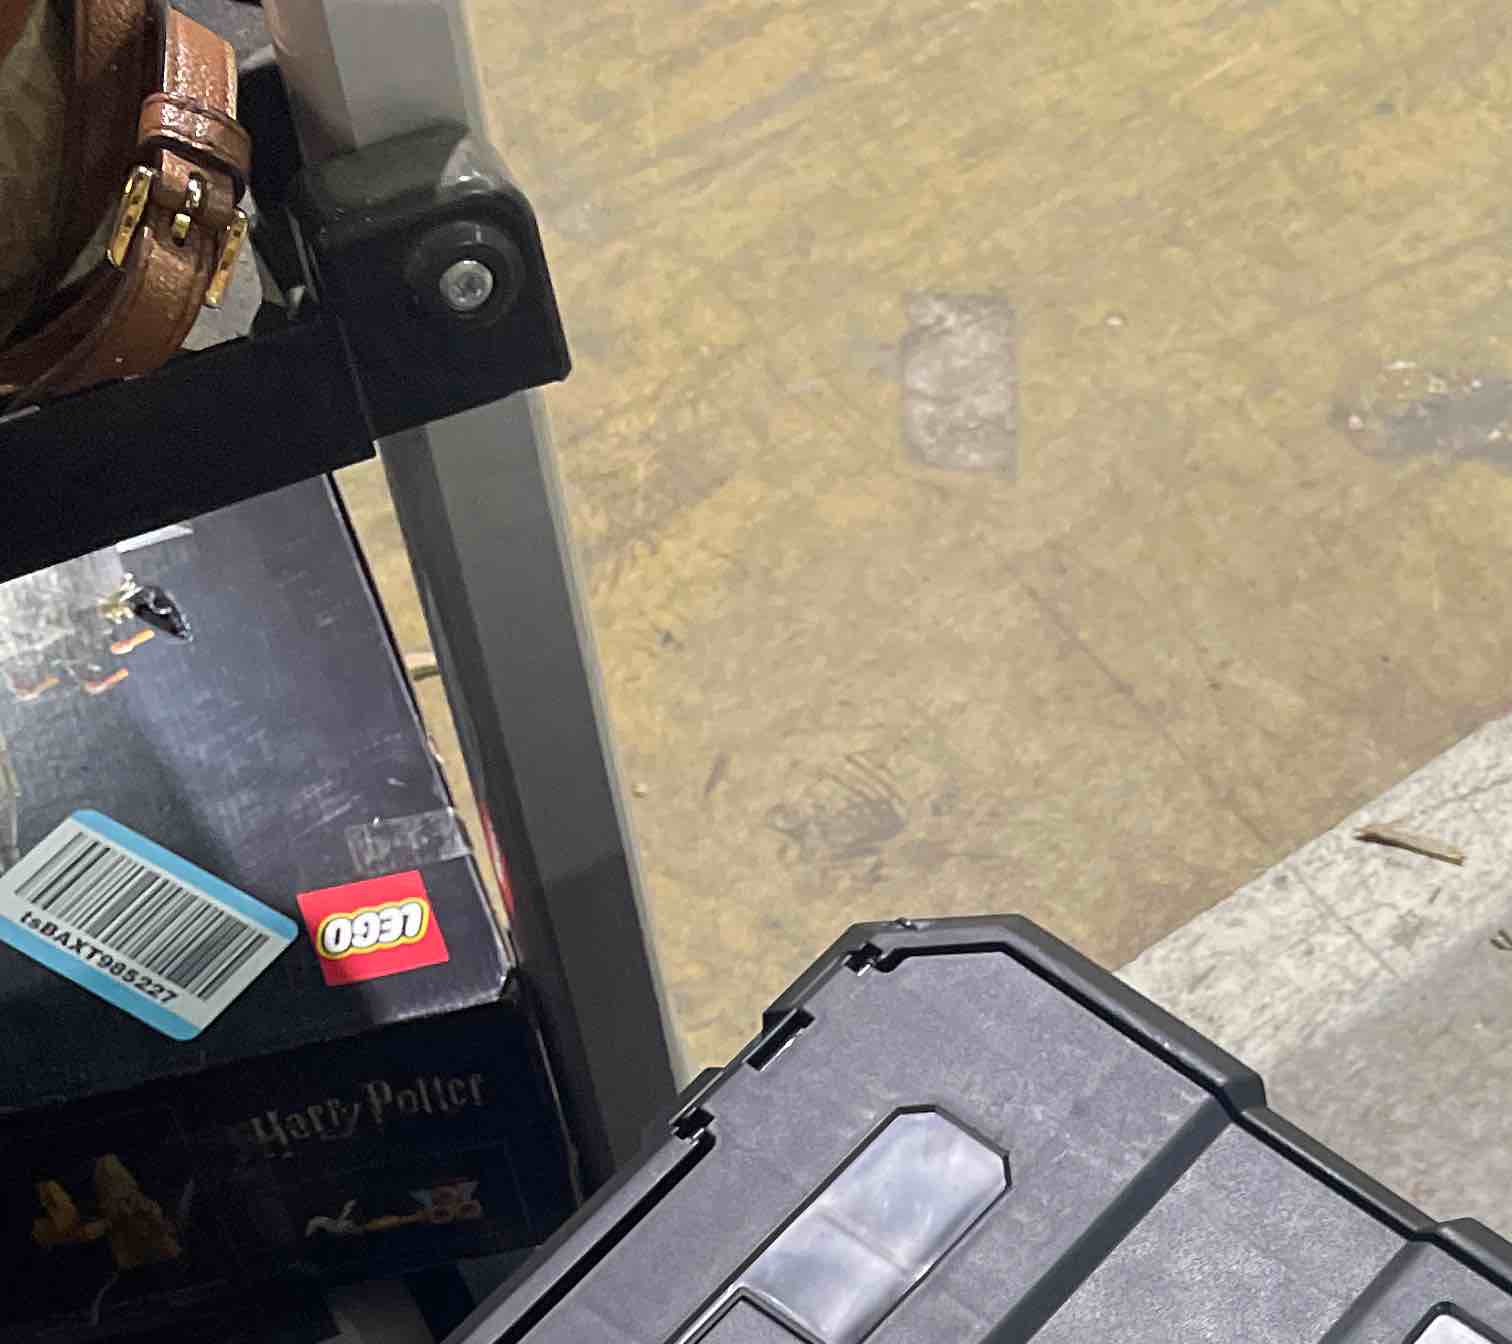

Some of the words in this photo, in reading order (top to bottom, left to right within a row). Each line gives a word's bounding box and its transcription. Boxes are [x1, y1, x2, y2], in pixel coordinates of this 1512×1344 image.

[319, 899, 427, 957] LEGO
[250, 1099, 360, 1147] Harry
[363, 1072, 487, 1125] Potter
